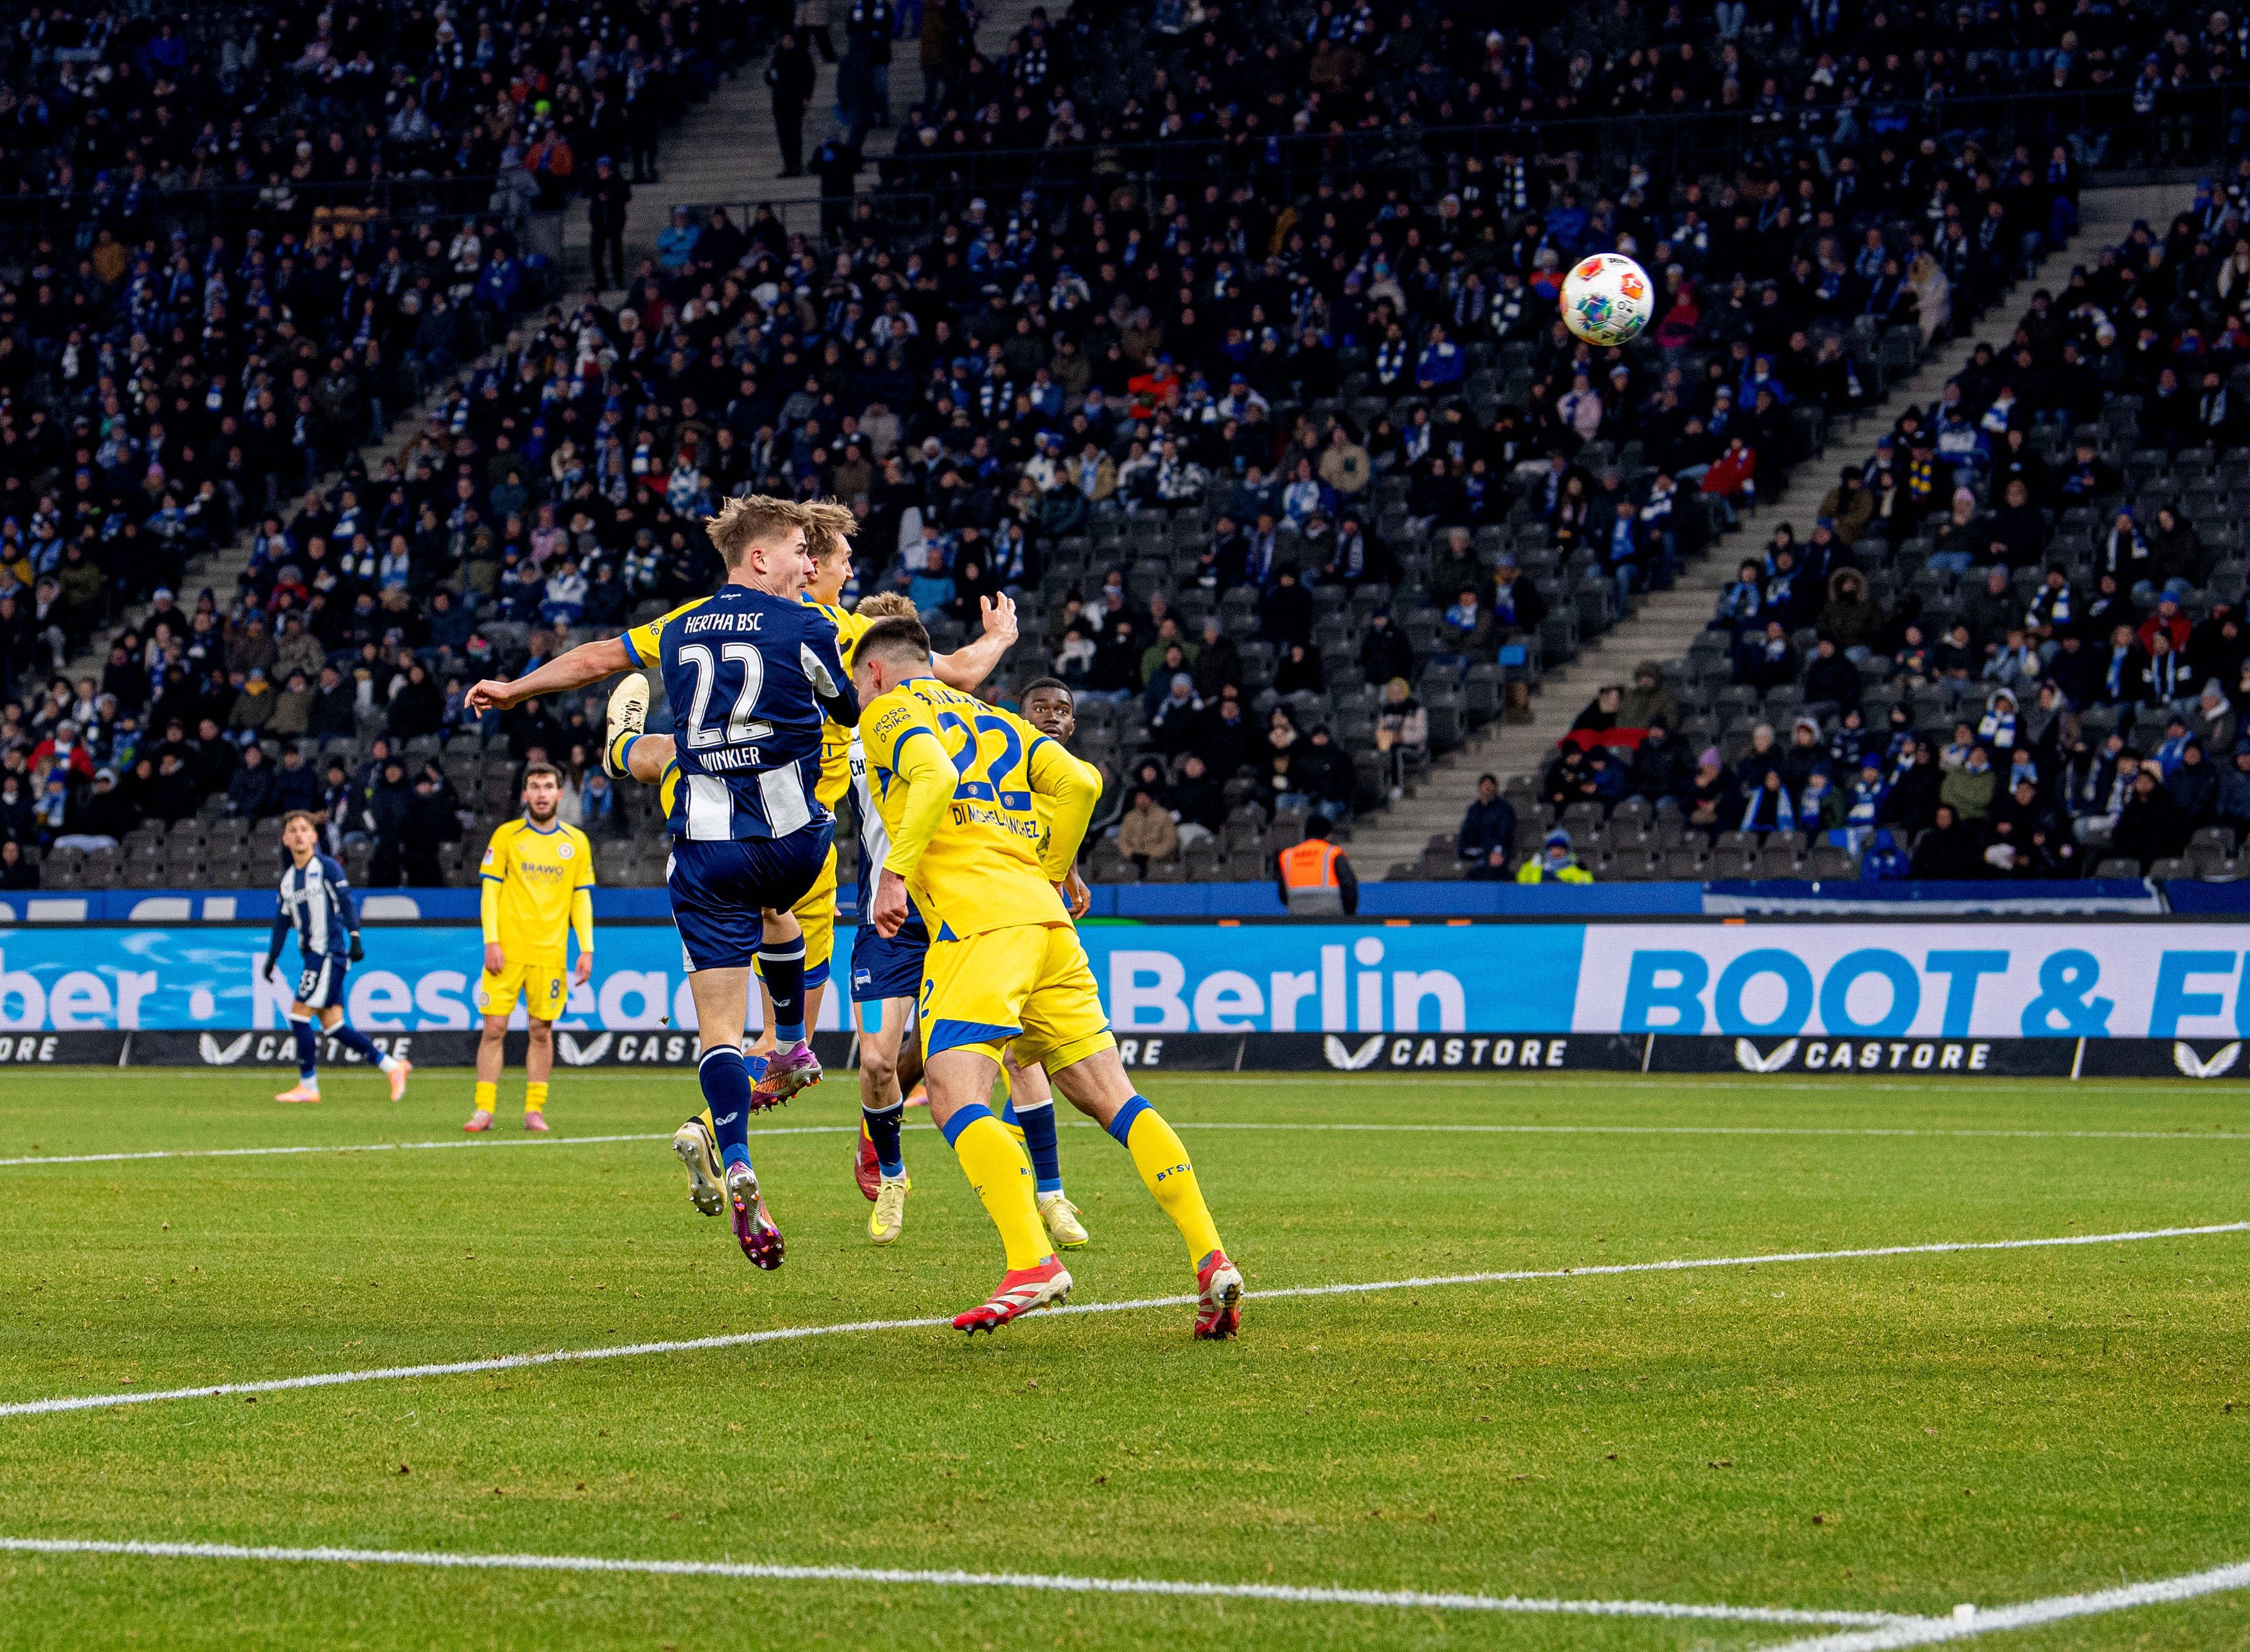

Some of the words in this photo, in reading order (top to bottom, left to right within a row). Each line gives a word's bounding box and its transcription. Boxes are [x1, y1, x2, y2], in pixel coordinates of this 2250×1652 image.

[684, 614, 734, 634] HERTHA
[736, 612, 764, 631] BSC
[678, 642, 774, 749] 22
[698, 746, 761, 771] WINKLER
[936, 711, 1032, 812] 22
[521, 862, 564, 876] BRAWO
[550, 979, 560, 999] 8
[1108, 936, 1466, 1033] Berlin
[1619, 947, 2011, 1038] BOOT
[2020, 948, 2115, 1038] &
[1389, 1038, 1568, 1067] CASTORE
[1804, 1041, 1991, 1070] CASTORE
[1156, 1163, 1190, 1182] BTSV
